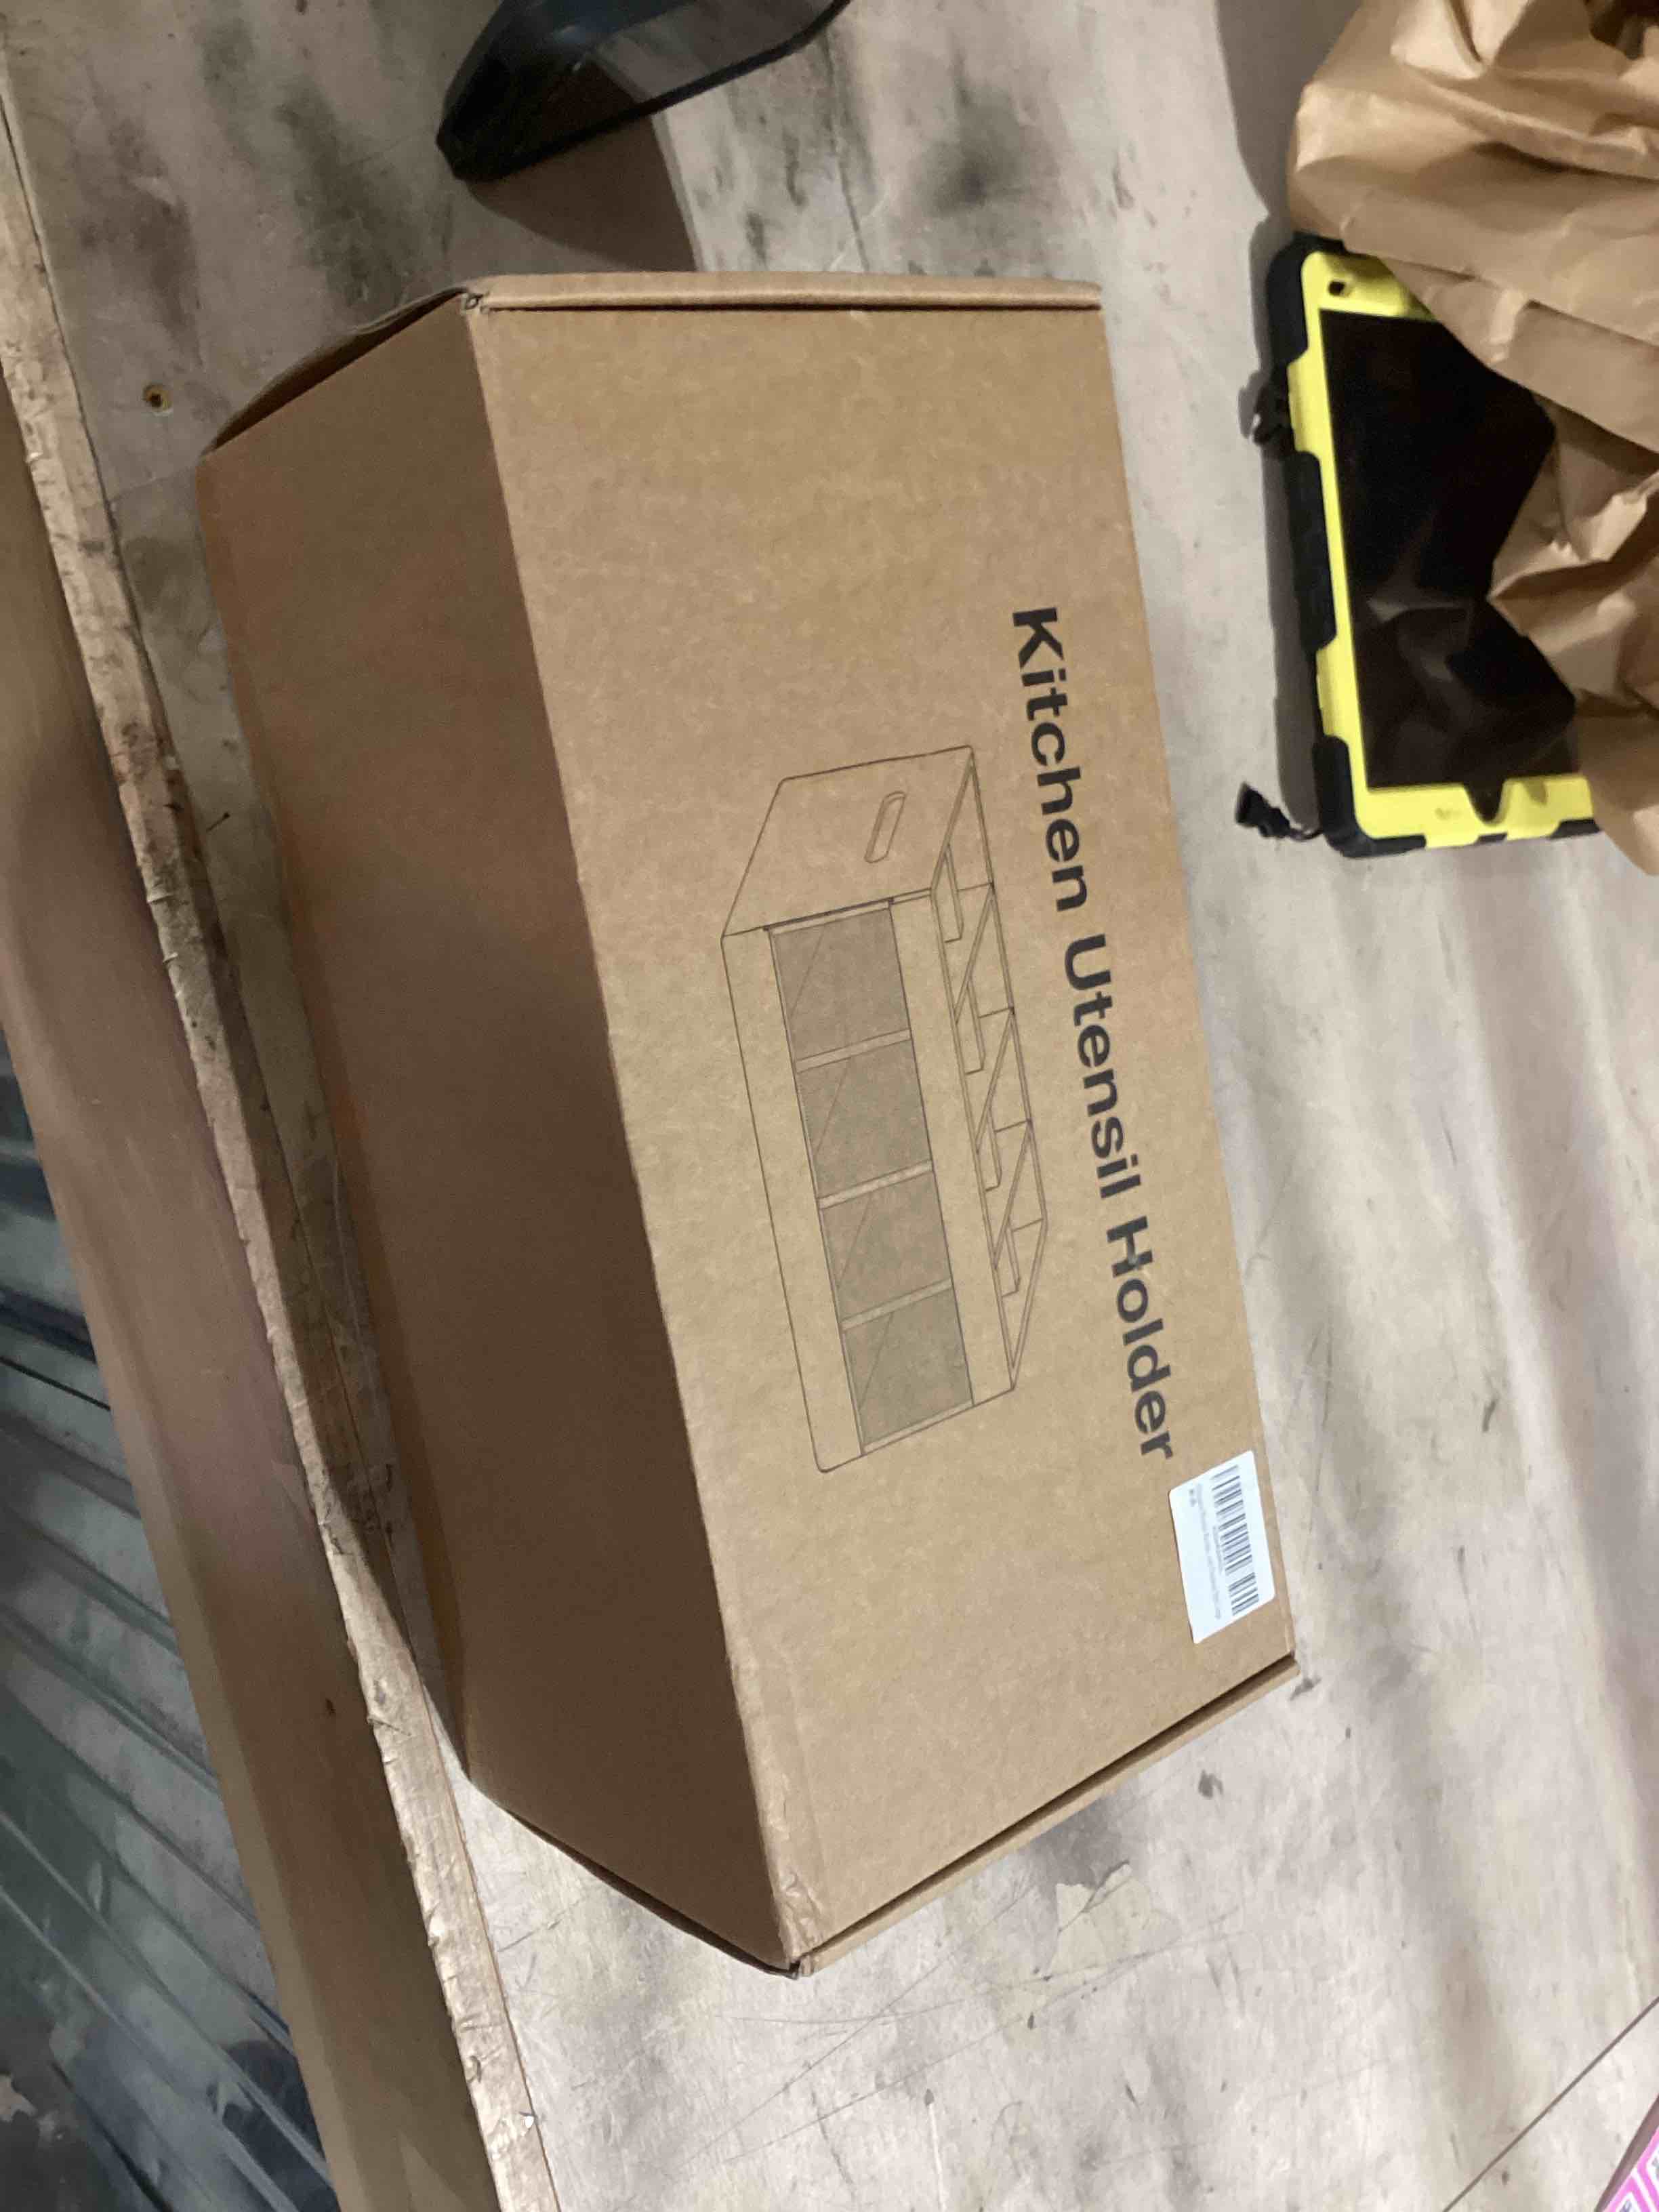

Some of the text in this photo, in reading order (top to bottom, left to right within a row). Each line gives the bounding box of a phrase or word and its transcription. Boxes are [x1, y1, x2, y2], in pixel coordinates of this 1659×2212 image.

[1012, 607, 1173, 1459] Kitchen Utensil Holder
